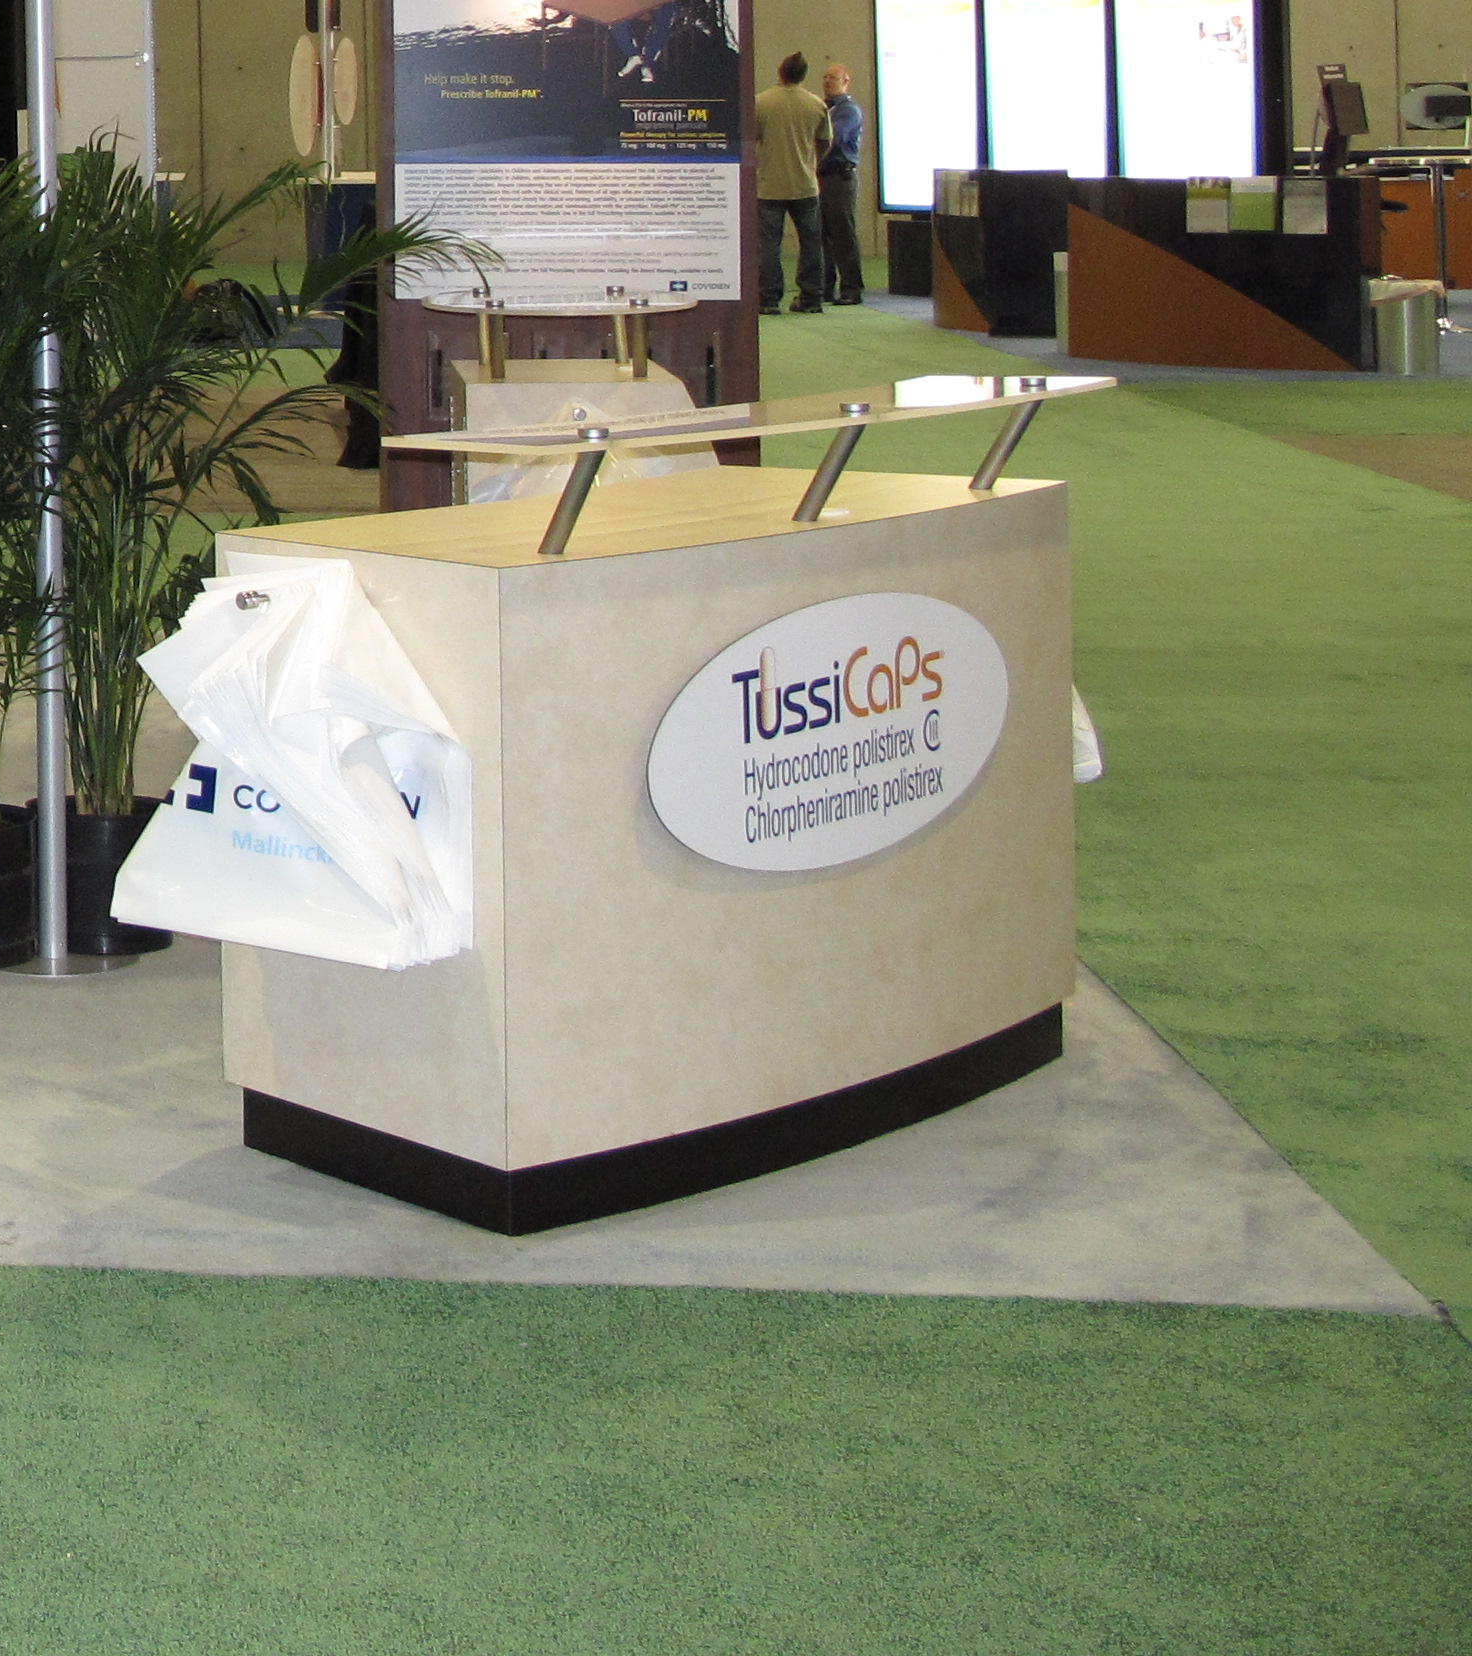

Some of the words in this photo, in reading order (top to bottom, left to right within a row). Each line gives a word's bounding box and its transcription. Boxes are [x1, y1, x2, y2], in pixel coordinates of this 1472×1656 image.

[423, 72, 449, 87] Help
[450, 73, 478, 85] make
[479, 72, 489, 85] it
[440, 88, 483, 100] Prescribe
[691, 282, 731, 290] COVIDIEN
[743, 743, 849, 800] Hydrocodone
[852, 724, 915, 777] polistirex
[745, 780, 879, 844] Chlorpheniramine
[882, 765, 944, 817] polistirex
